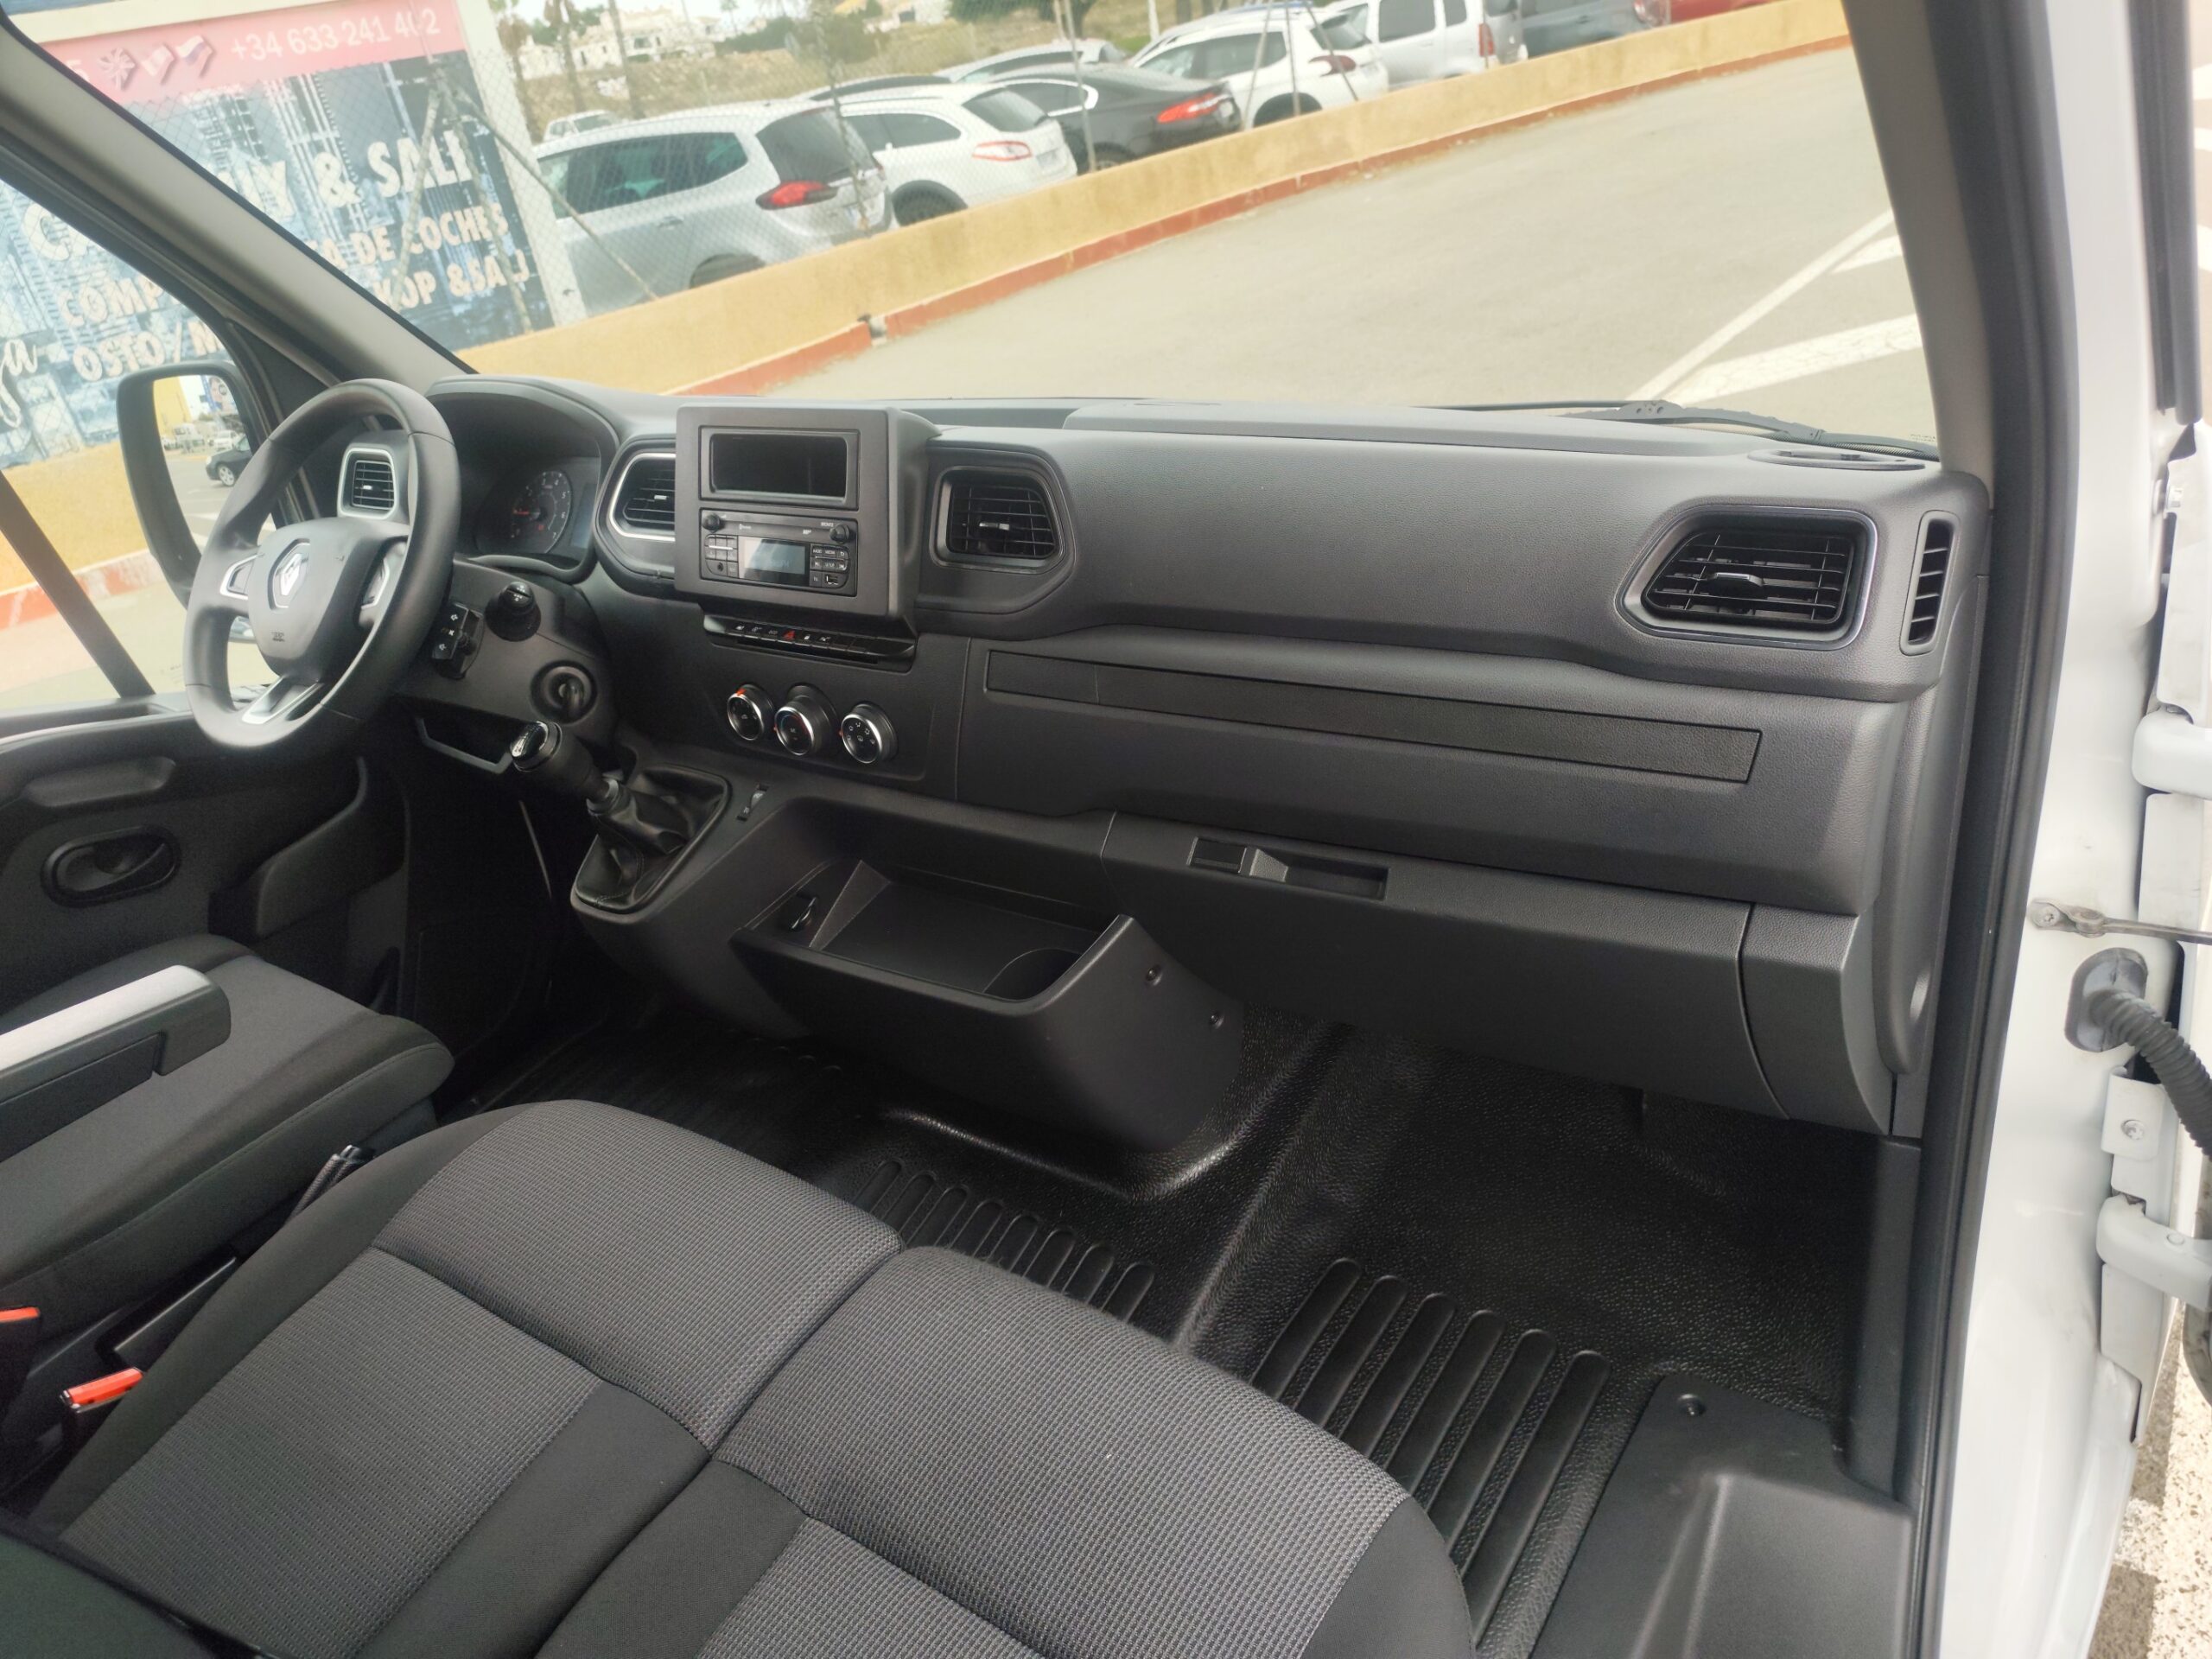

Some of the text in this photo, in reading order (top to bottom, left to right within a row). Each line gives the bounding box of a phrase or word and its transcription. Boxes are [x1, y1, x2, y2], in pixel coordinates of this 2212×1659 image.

[232, 33, 283, 61] +34
[288, 25, 339, 55] 633
[345, 17, 391, 48] 241
[314, 151, 360, 208] &
[350, 225, 396, 265] DE
